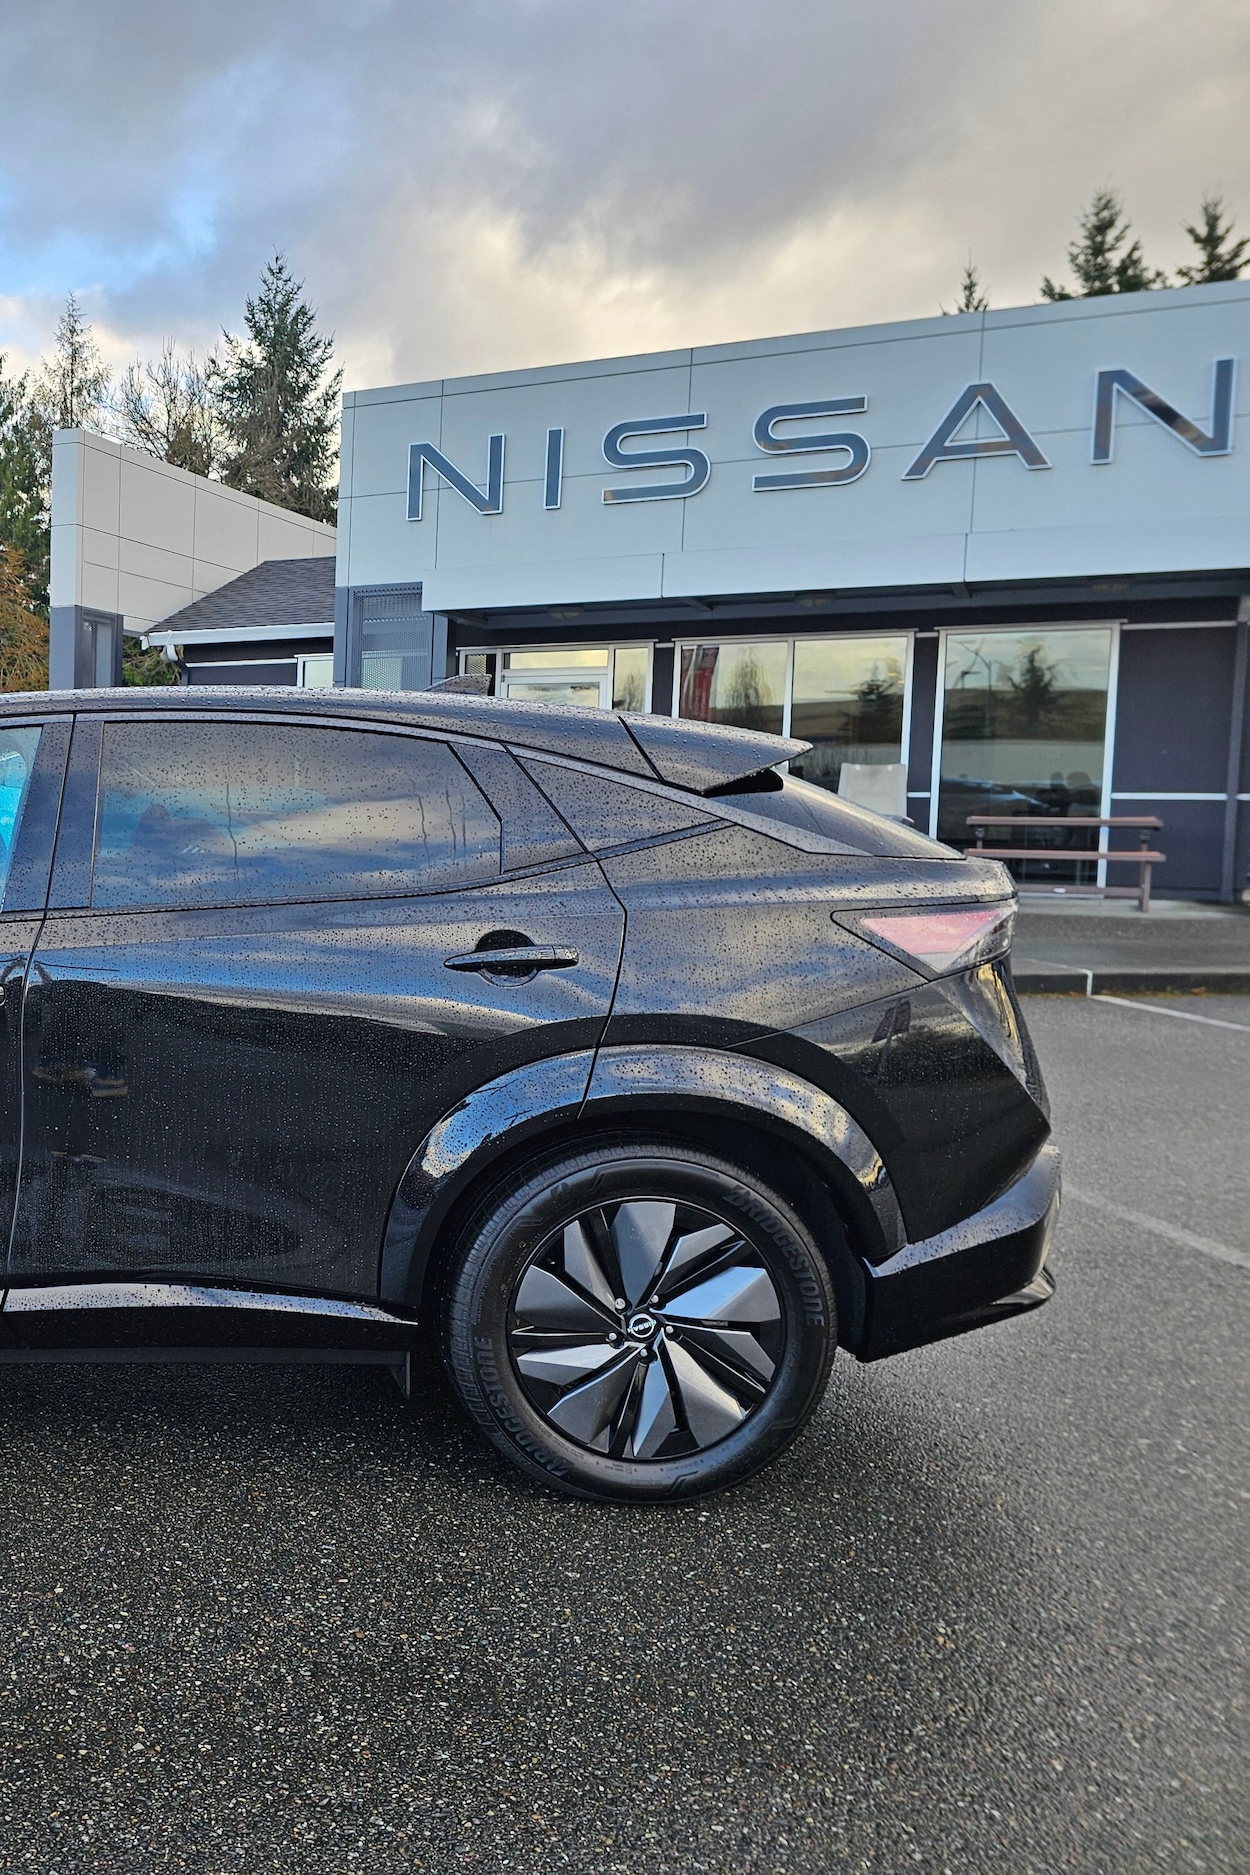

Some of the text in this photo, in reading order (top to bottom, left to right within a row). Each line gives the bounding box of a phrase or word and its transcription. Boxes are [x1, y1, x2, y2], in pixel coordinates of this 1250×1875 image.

[406, 356, 1238, 522] NISSAN
[722, 1184, 825, 1328] BRIDGESTONE
[474, 1336, 576, 1478] BRIDGESTONE
